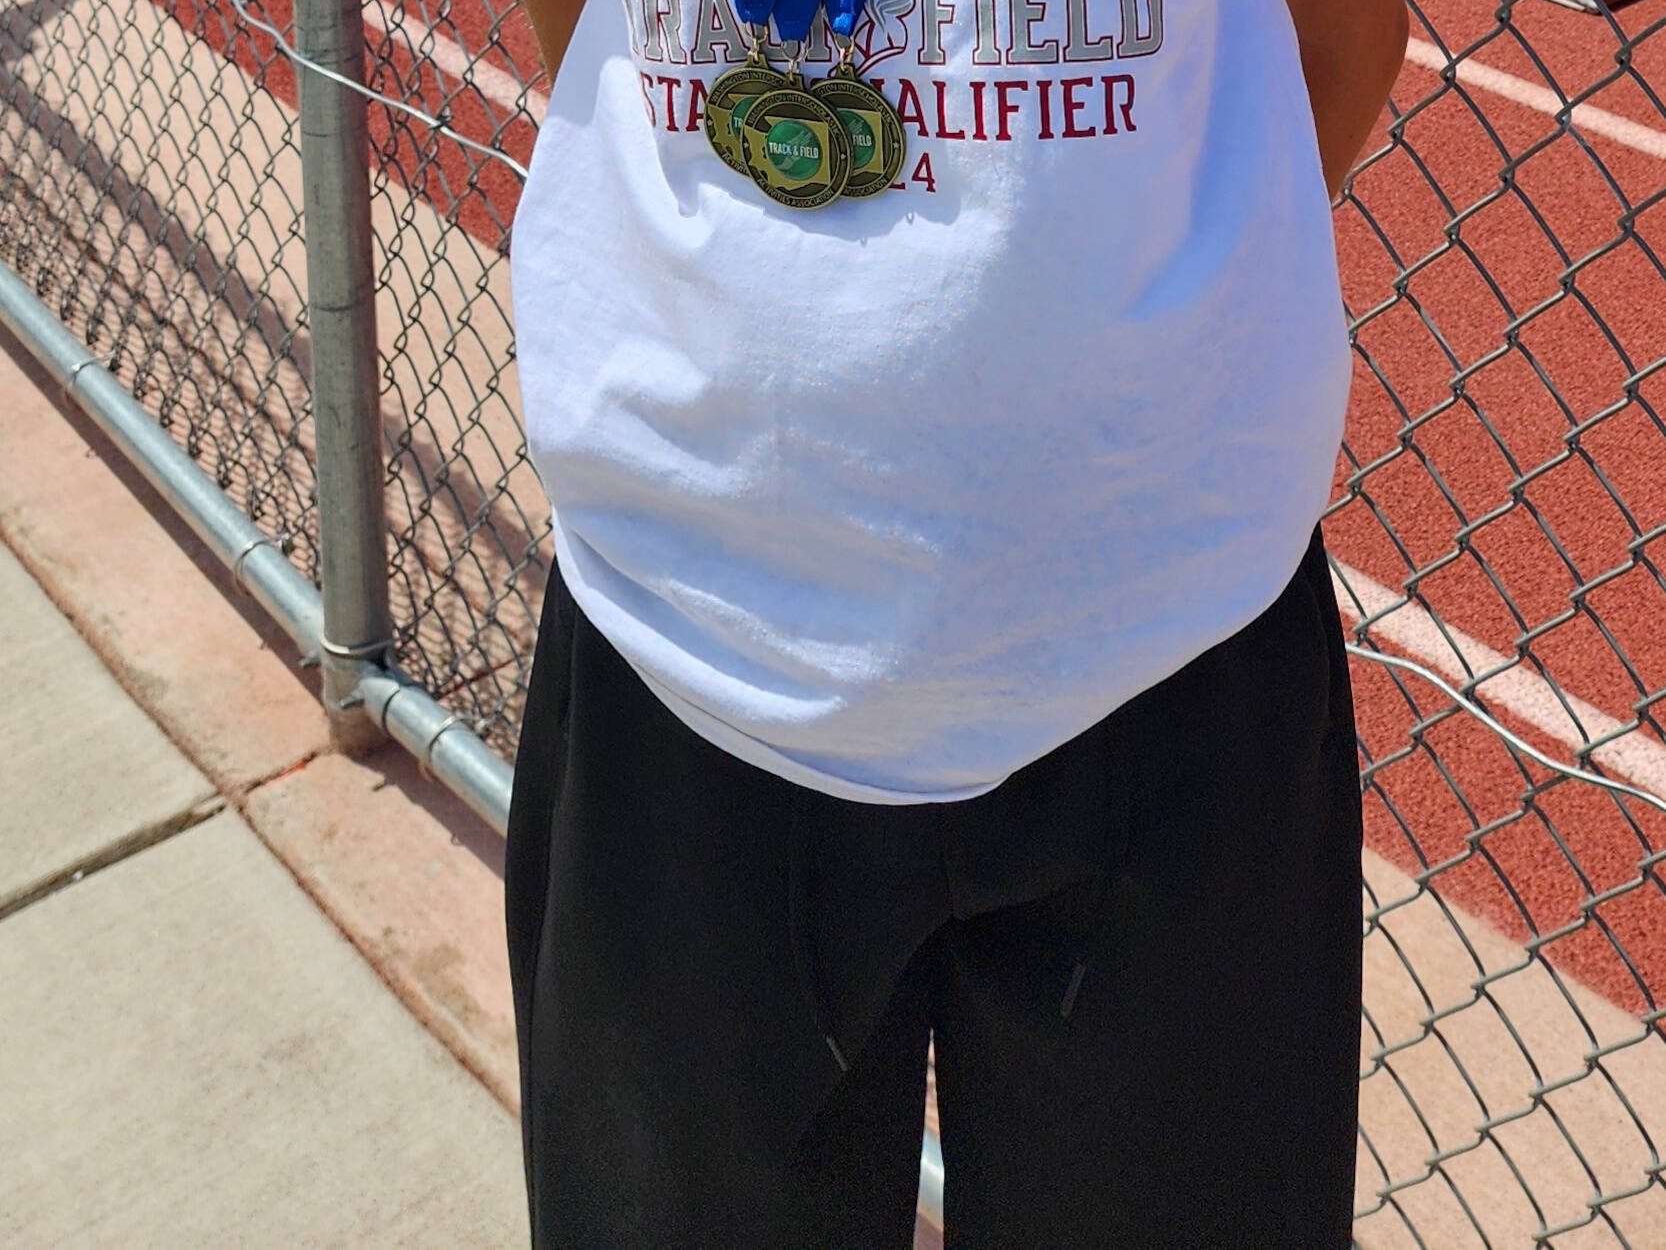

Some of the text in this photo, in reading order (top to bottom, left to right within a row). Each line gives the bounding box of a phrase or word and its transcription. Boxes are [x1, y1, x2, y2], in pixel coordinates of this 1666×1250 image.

[868, 74, 1138, 142] ALIFIER
[851, 134, 873, 147] FIELD
[768, 141, 820, 159] TRACK & FIELD
